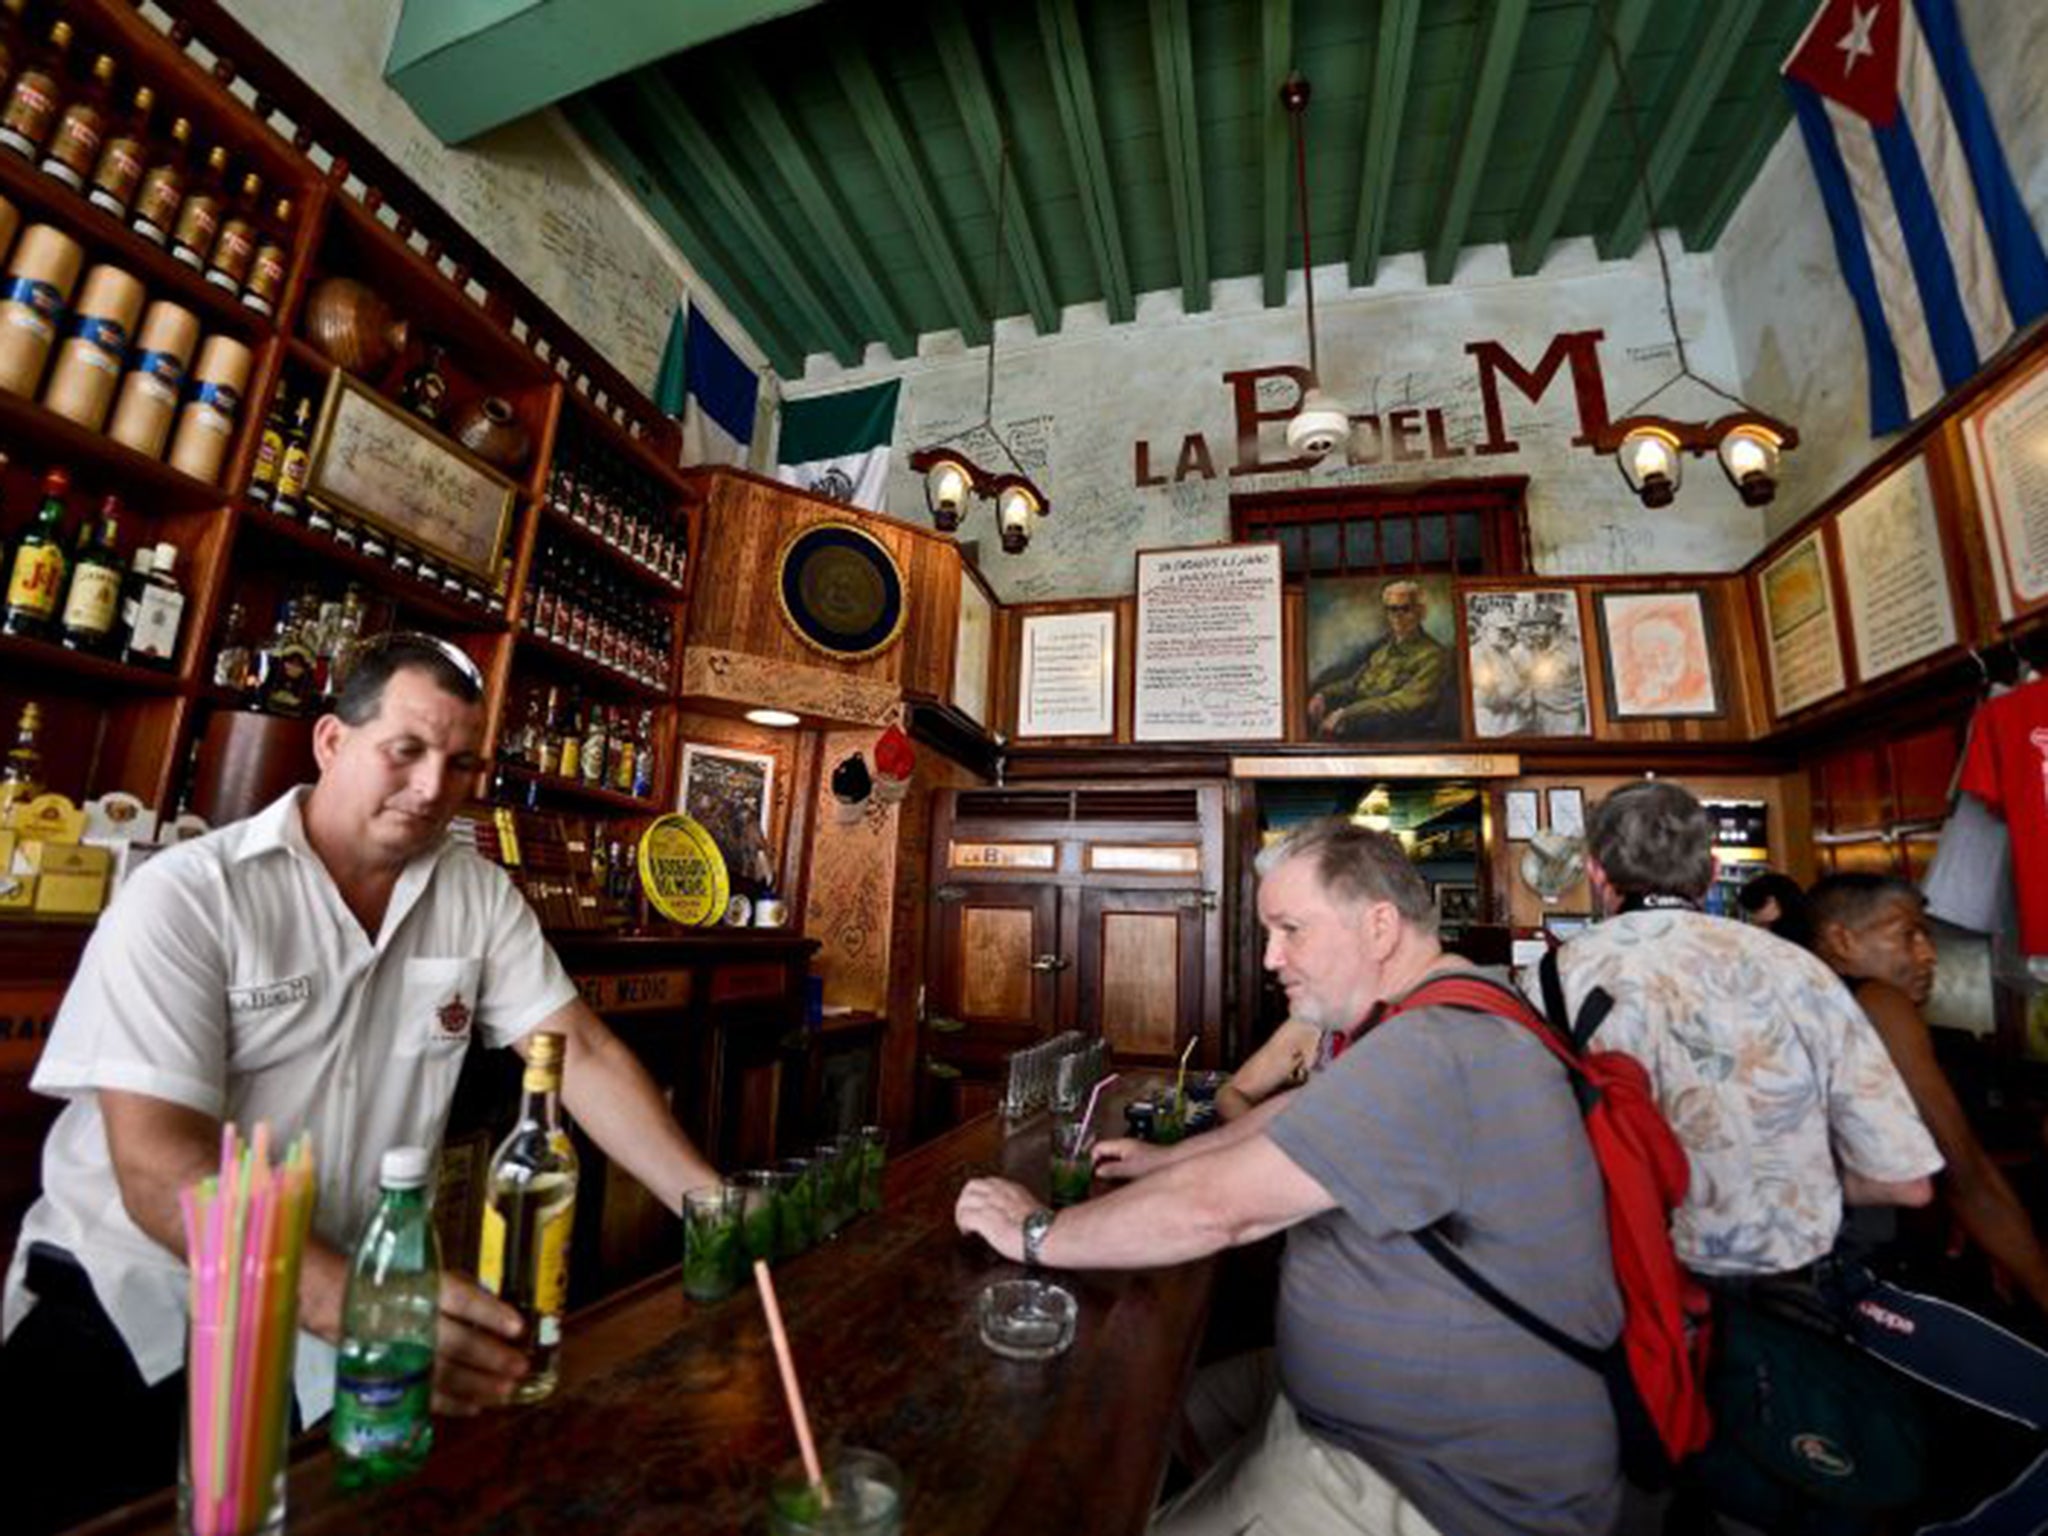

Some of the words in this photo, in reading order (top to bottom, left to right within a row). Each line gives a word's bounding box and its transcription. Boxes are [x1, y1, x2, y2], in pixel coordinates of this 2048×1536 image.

[1134, 432, 1216, 488] LA
[1222, 363, 1326, 476] B
[1348, 407, 1465, 466] DEL
[1465, 330, 1610, 456] M
